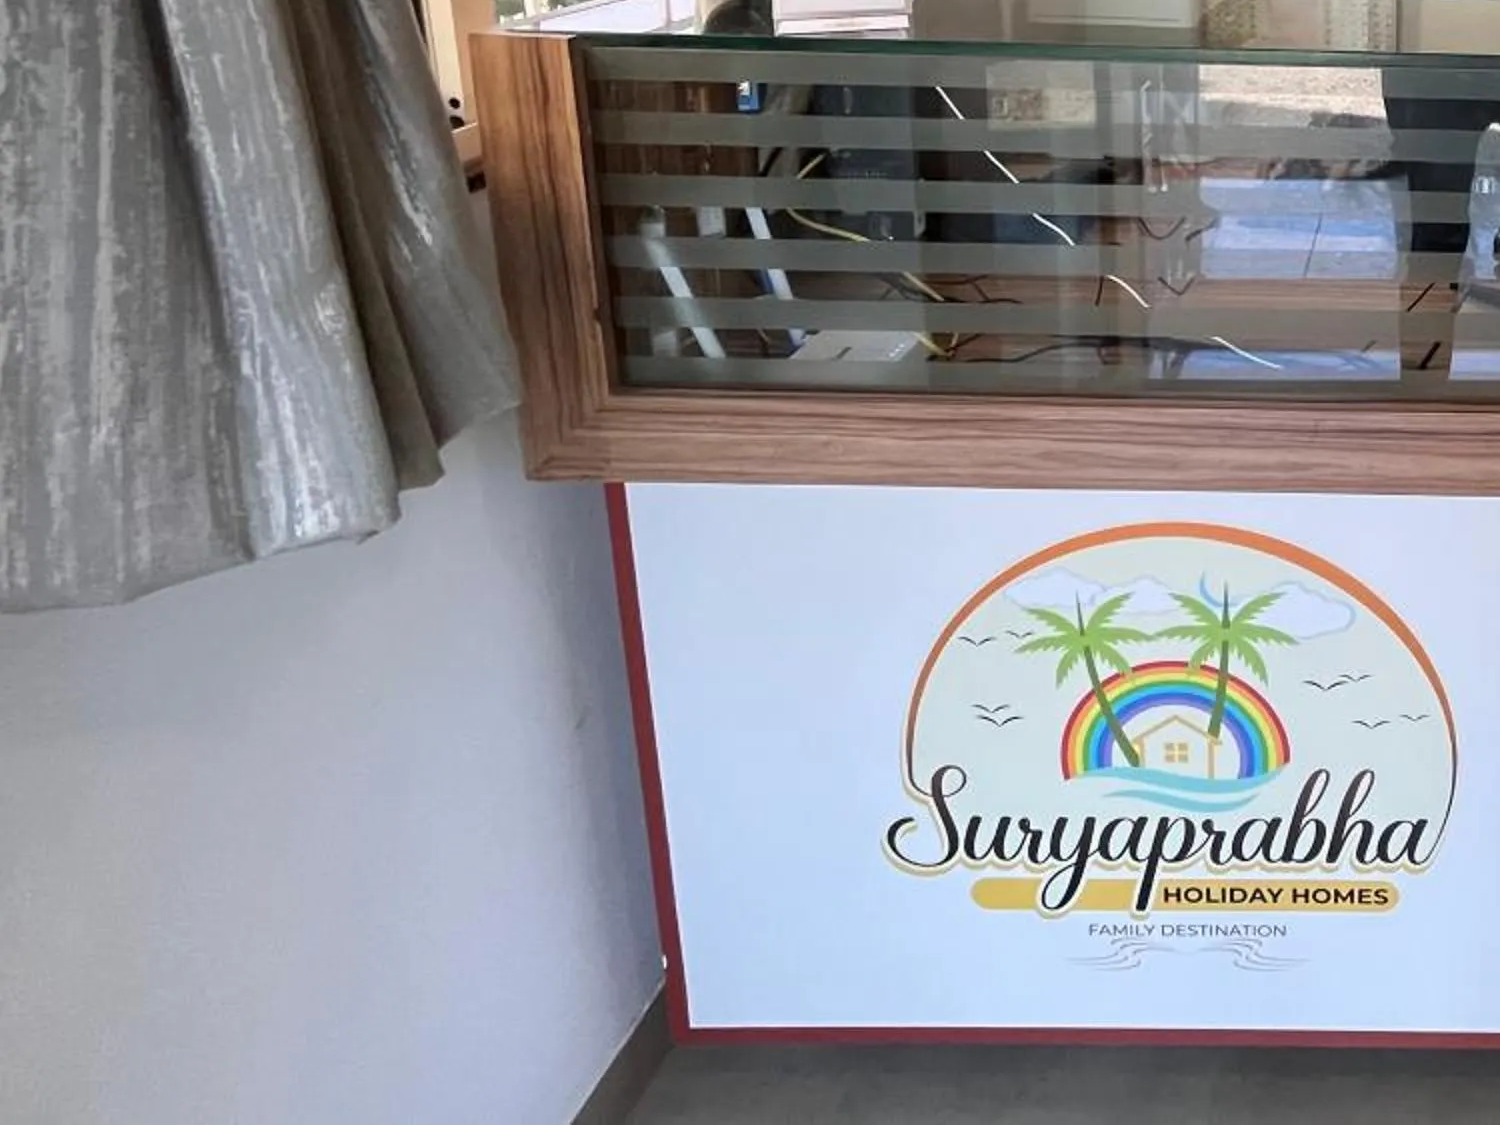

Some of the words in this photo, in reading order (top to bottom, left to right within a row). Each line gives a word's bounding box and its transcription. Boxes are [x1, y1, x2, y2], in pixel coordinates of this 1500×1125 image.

[886, 765, 1440, 912] Suryaprabha
[1163, 886, 1284, 905] HOLIDAY
[1291, 887, 1390, 906] HOMES
[1088, 923, 1156, 937] FAMILY
[1160, 923, 1288, 937] DESTINATION
